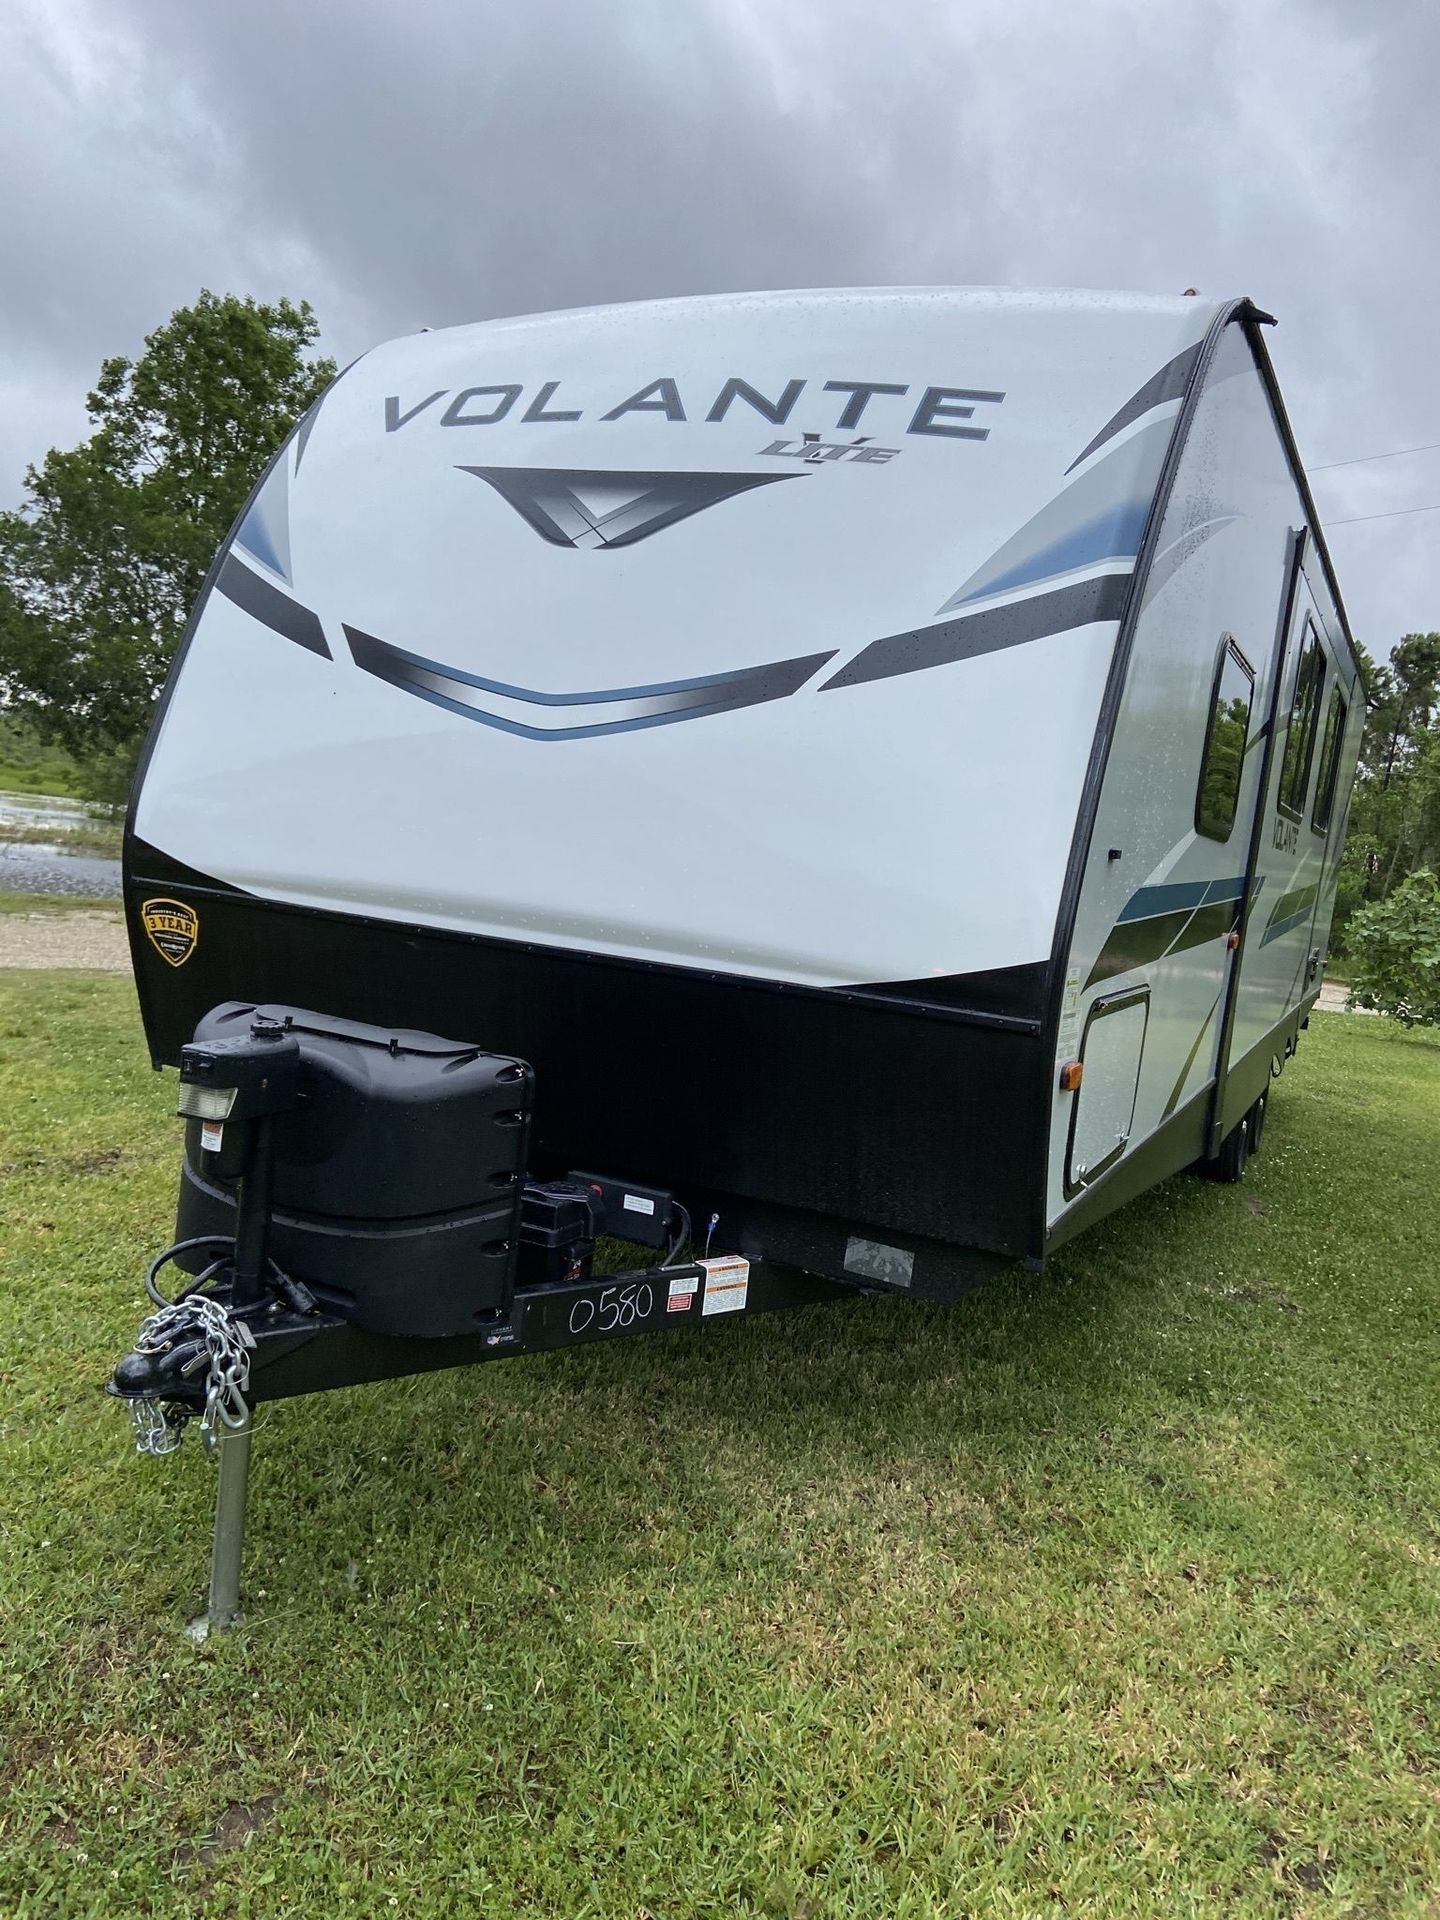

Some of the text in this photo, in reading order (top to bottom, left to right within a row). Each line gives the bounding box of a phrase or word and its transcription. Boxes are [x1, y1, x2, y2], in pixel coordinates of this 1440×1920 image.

[385, 377, 1007, 441] VOLANTE
[755, 439, 903, 464] LITE
[1272, 816, 1299, 856] VOLANTE
[148, 916, 193, 935] 3 YEAR
[569, 1283, 653, 1333] 0580
